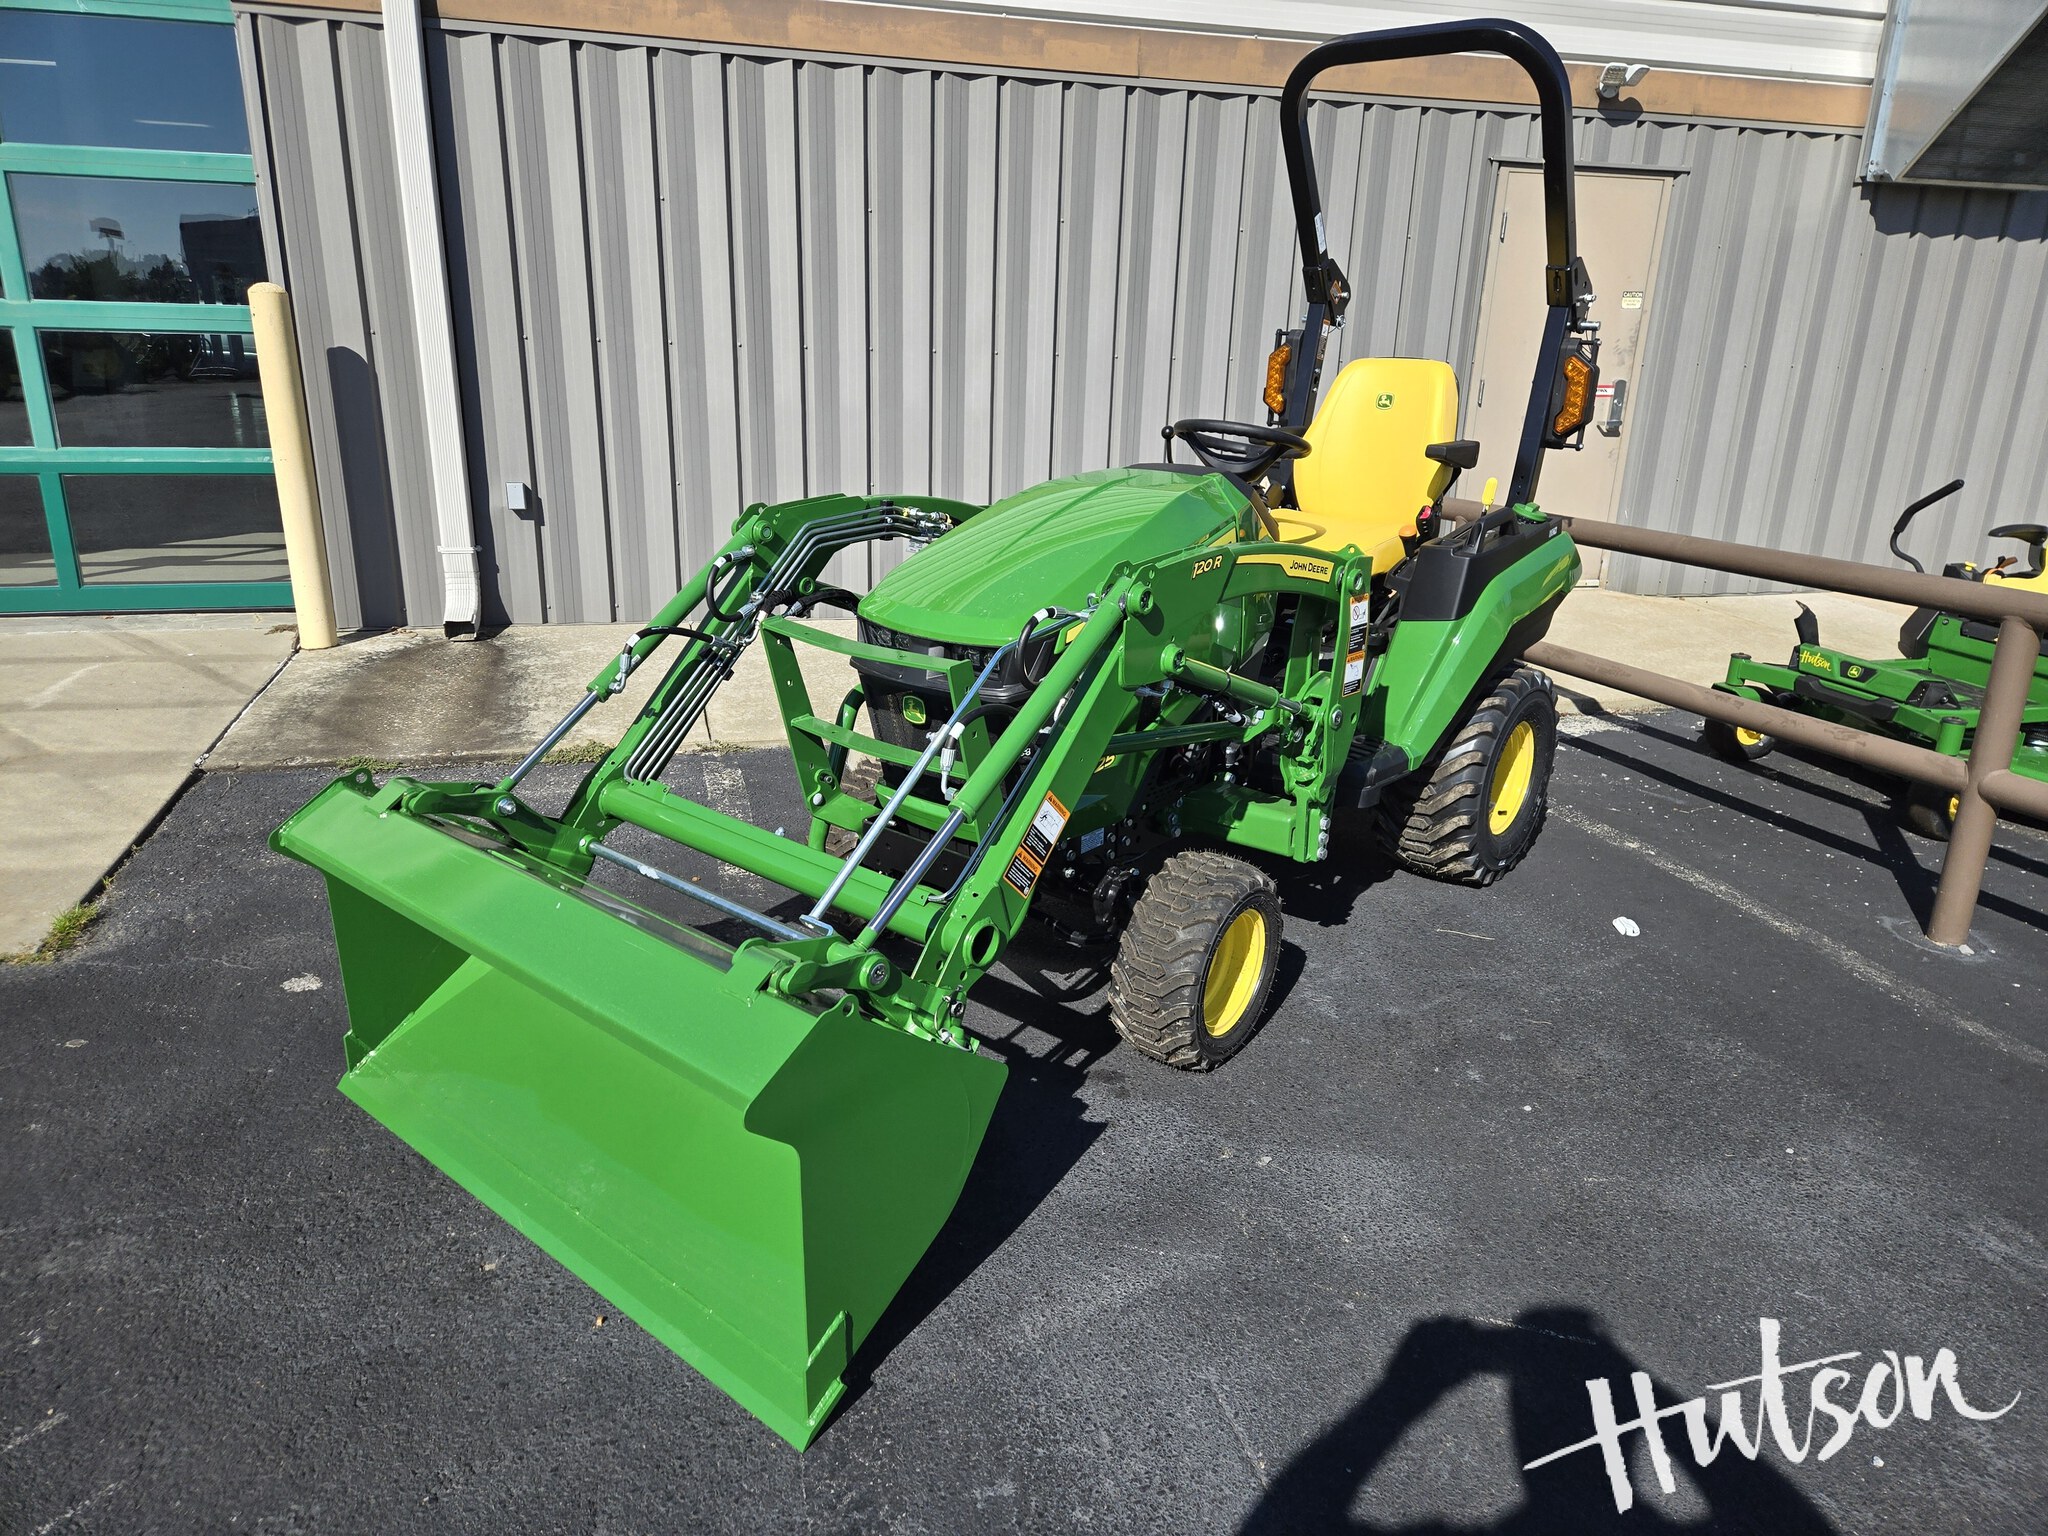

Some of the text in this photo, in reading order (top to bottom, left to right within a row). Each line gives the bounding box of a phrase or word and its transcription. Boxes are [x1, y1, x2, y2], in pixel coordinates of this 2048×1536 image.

[1290, 560, 1328, 575] JOHN DEERE
[1800, 651, 1832, 671] Hutson
